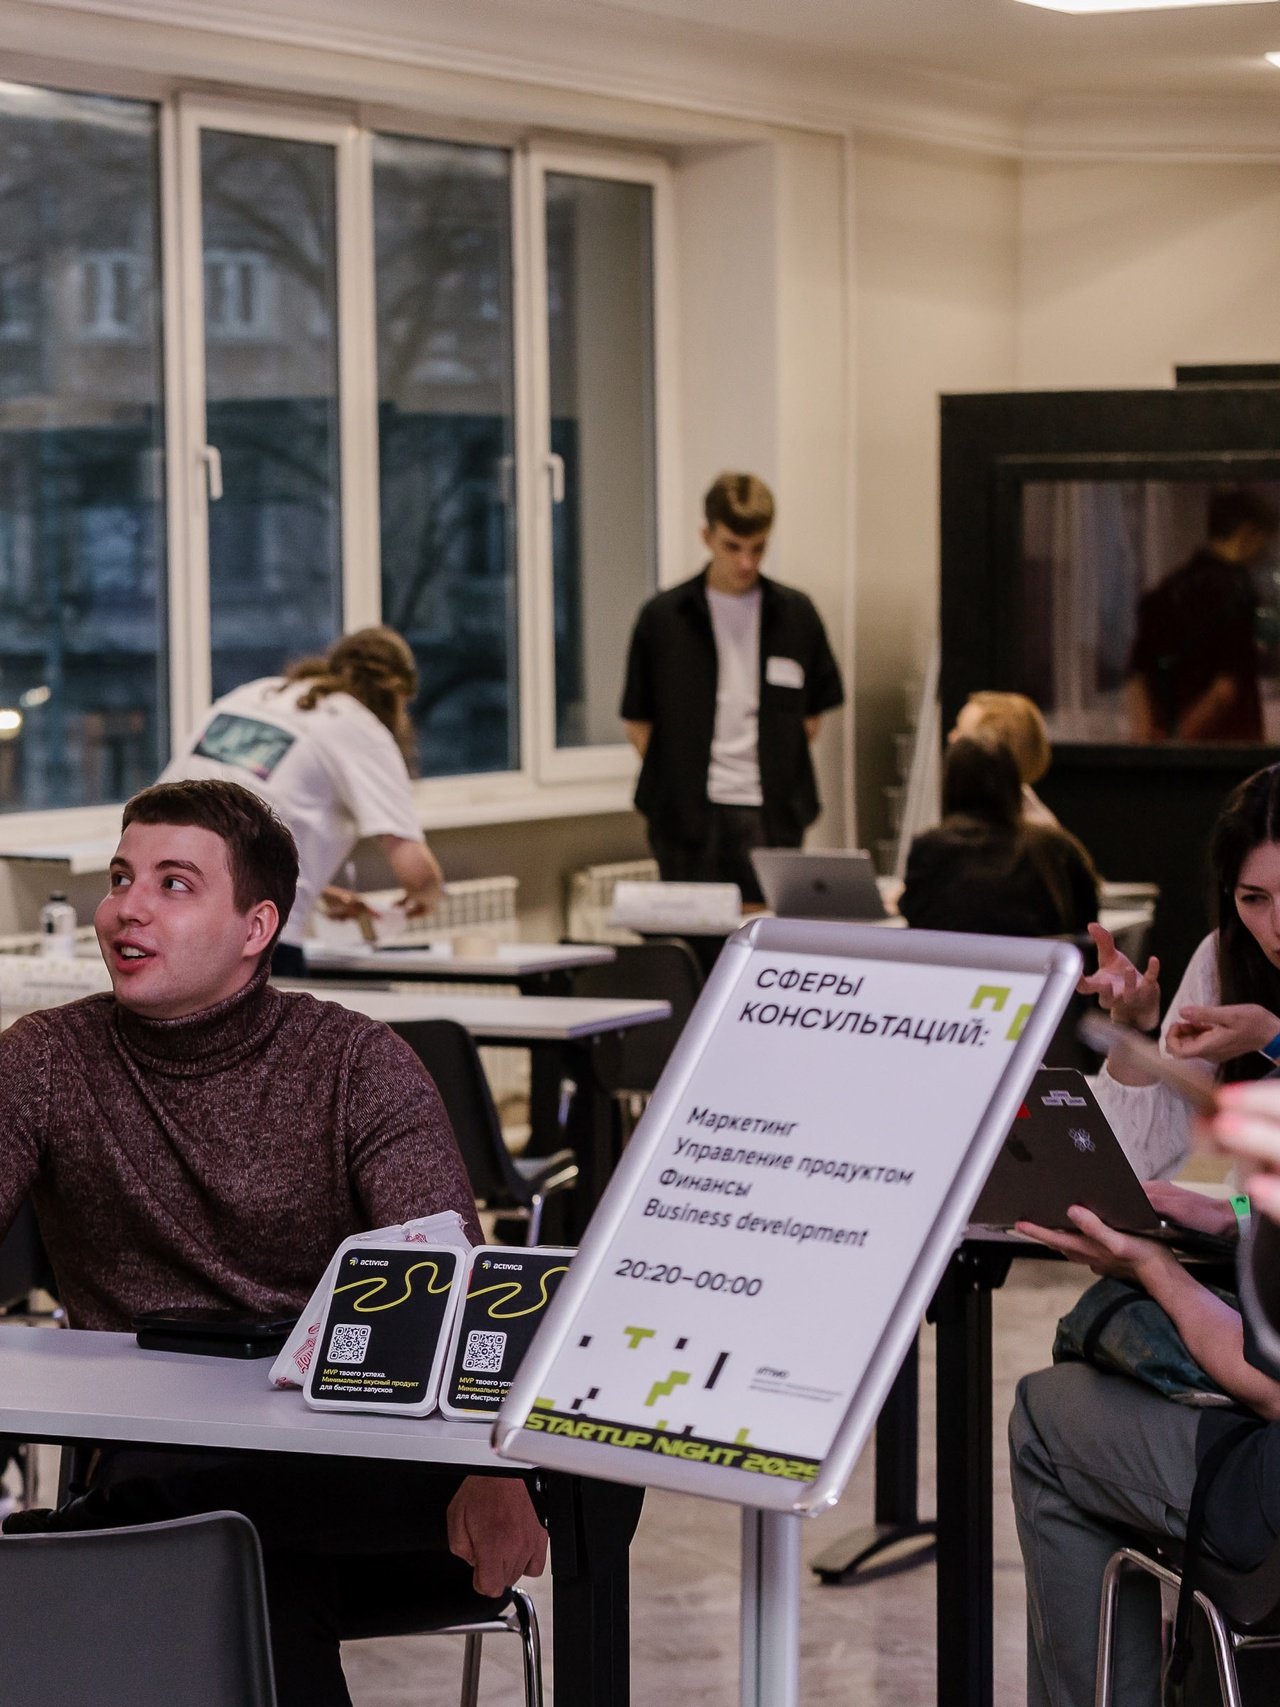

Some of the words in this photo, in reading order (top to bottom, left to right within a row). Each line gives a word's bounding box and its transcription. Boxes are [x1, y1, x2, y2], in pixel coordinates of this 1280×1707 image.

[756, 968, 867, 997] СФЕРЫ
[738, 1001, 992, 1047] КОНСУЛЬТАЦИЙ:
[687, 1106, 800, 1138] Маркетинг
[672, 1136, 795, 1171] Управление
[795, 1156, 916, 1186] продуктом
[658, 1167, 754, 1198] Финансы
[643, 1197, 731, 1229] Business
[734, 1211, 870, 1249] development
[359, 1258, 390, 1268] activica
[492, 1261, 524, 1272] activica
[322, 1368, 339, 1376] MVP
[338, 1369, 362, 1378] твоего
[321, 1376, 363, 1385] Минимально
[391, 1380, 420, 1388] продукт
[459, 1376, 475, 1384] MVP
[475, 1379, 499, 1387] твоего
[319, 1383, 333, 1391] для
[333, 1383, 363, 1394] быстрых
[363, 1386, 394, 1395] запусков
[457, 1385, 500, 1394] Минимально
[455, 1393, 470, 1401] для
[470, 1393, 500, 1403] быстрых
[524, 1411, 653, 1450] STARTUP
[652, 1433, 744, 1468] NIGHT
[739, 1452, 822, 1484] 2025
